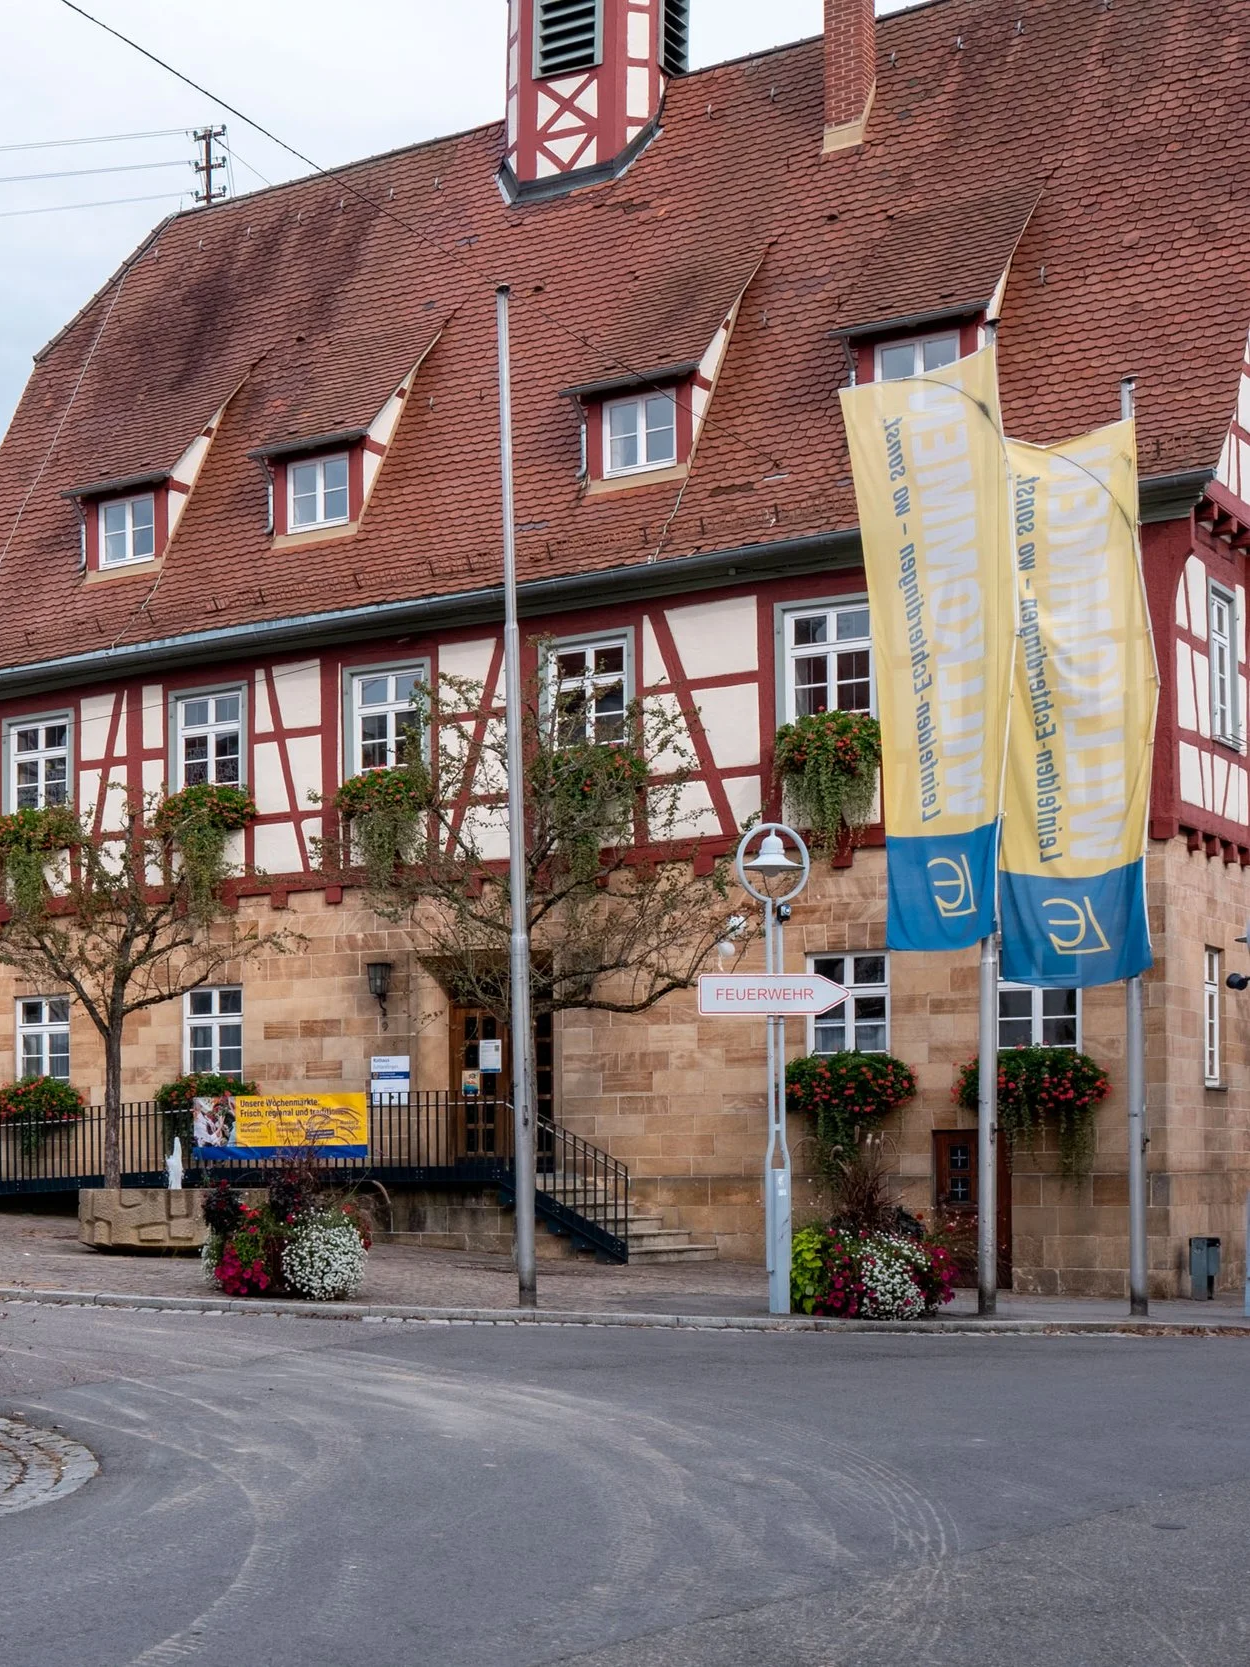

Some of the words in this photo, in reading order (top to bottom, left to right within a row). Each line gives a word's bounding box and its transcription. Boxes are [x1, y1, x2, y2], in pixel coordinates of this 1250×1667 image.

[716, 988, 814, 1001] FEUERWEHR
[240, 1099, 264, 1108] Unsere
[240, 1109, 263, 1118] Frisch,
[265, 1109, 293, 1119] regional
[295, 1108, 309, 1116] und
